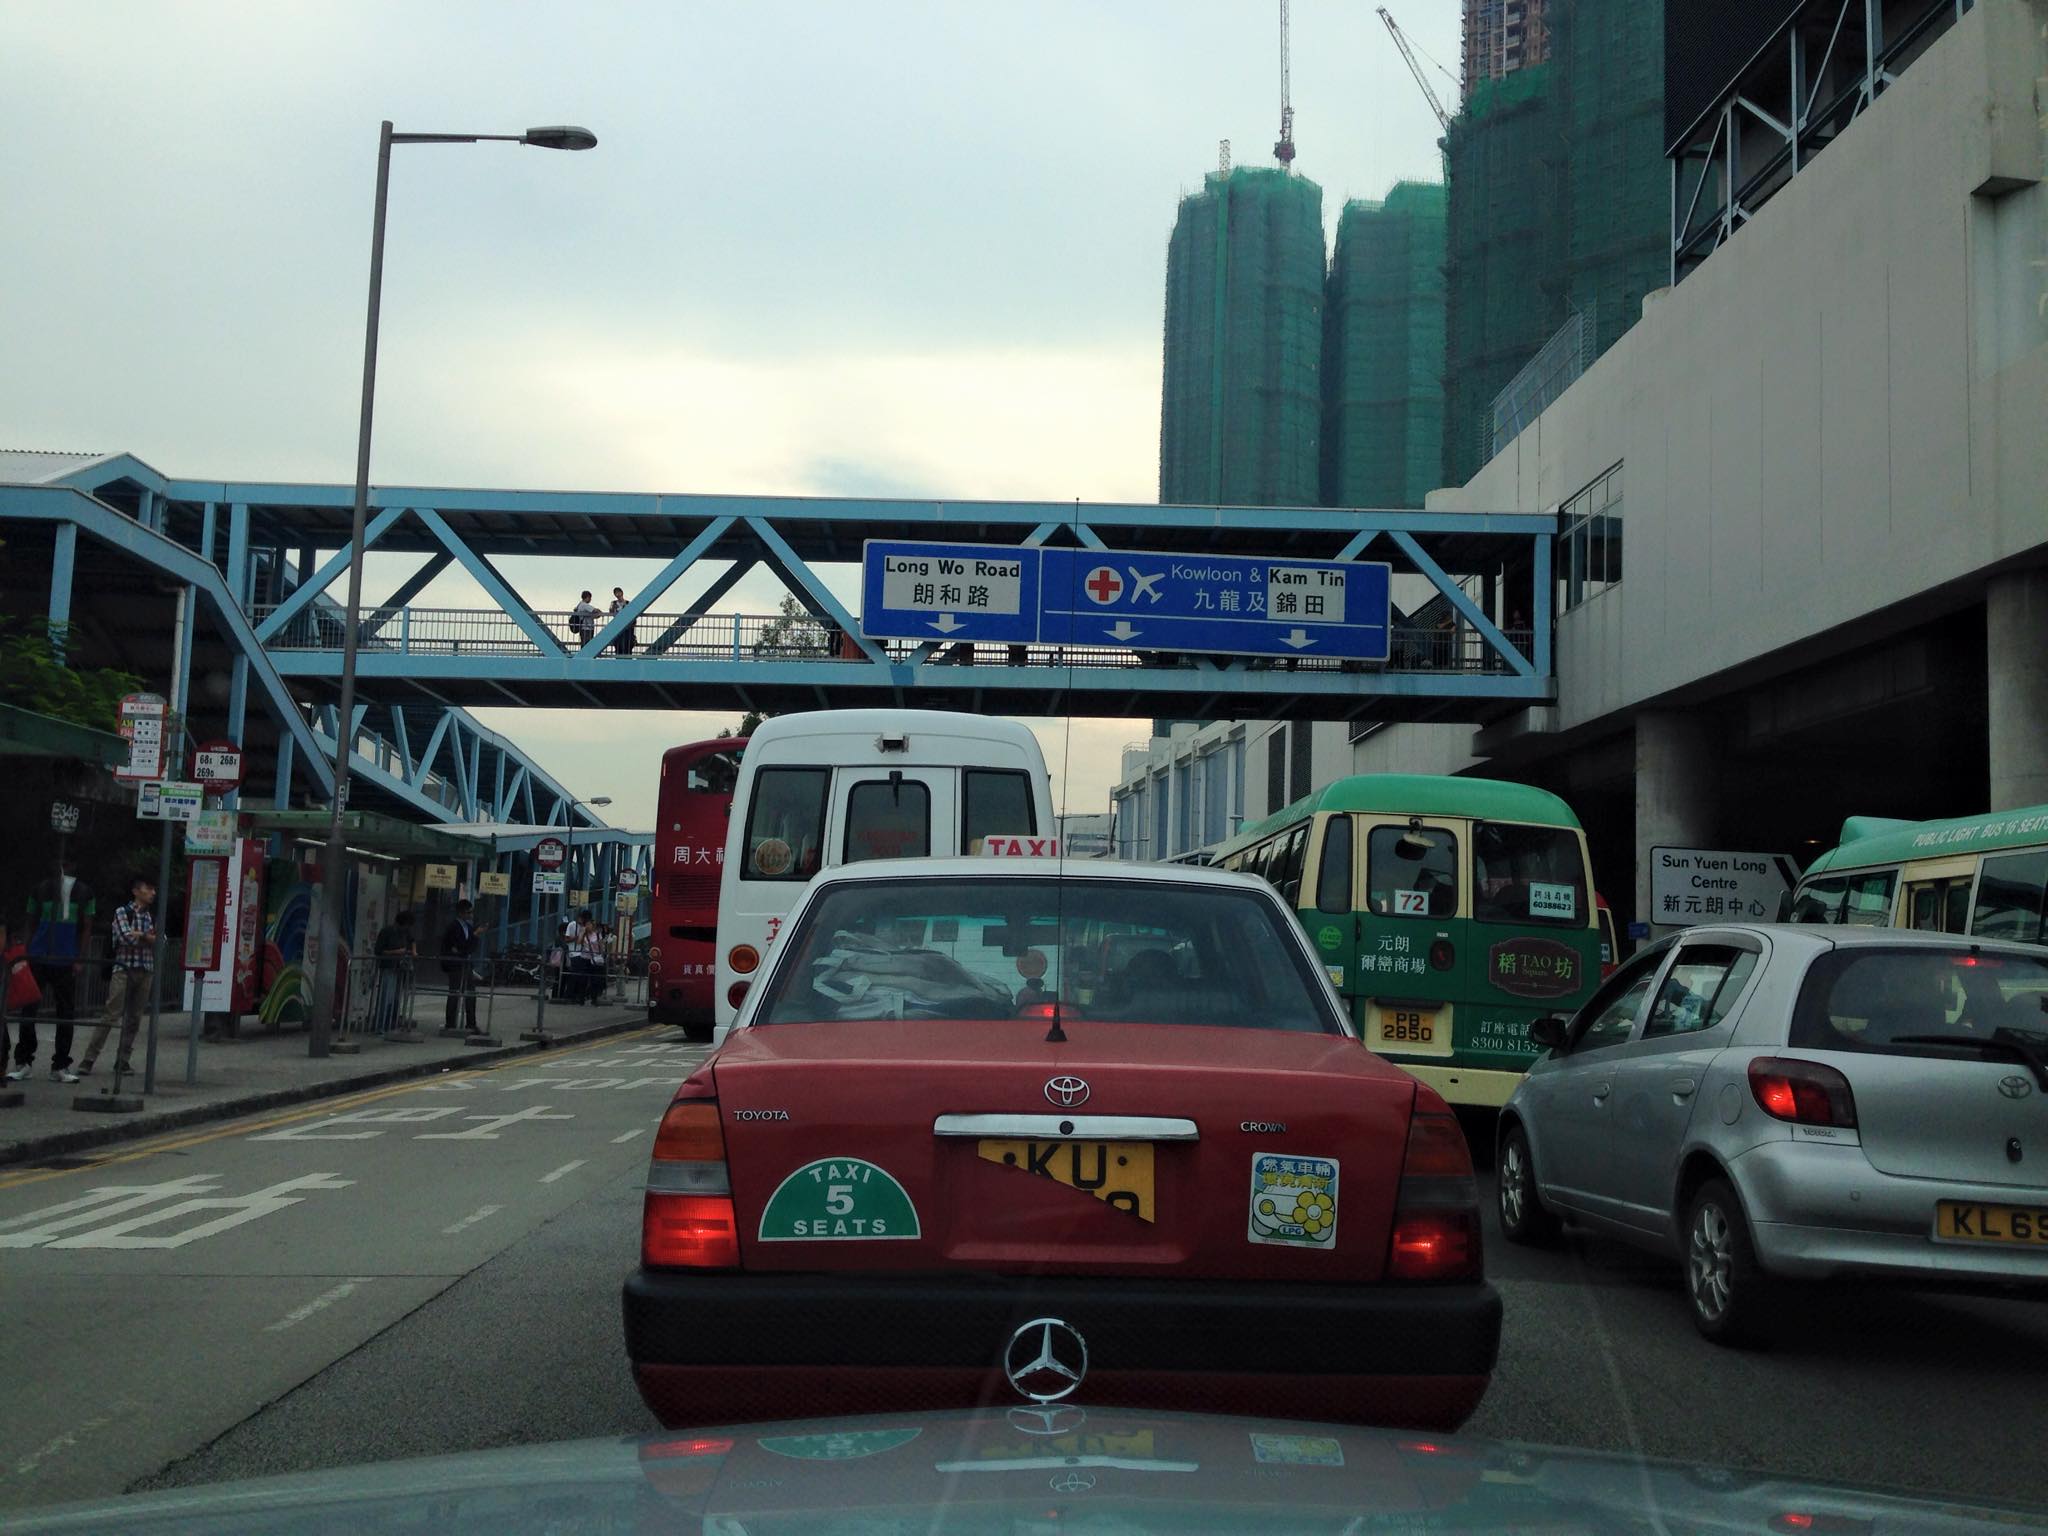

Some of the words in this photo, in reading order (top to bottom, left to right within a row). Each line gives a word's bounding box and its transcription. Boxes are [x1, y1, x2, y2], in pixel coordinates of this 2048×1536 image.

[886, 557, 929, 576] Long
[938, 559, 965, 575] Wo
[975, 561, 1020, 577] Road
[1171, 564, 1242, 582] Kowloon
[1250, 567, 1262, 582] &
[1269, 569, 1308, 585] Kam
[1317, 571, 1344, 586] Tin
[913, 583, 989, 607] 朗和路
[1912, 829, 1949, 847] PUBLIC
[1947, 826, 1980, 843] LIGHT
[1981, 822, 2005, 838] BUS
[2004, 819, 2020, 835] 16
[988, 839, 1057, 857] TAXI
[1662, 855, 1689, 868] Sun
[1694, 857, 1728, 870] Yuen
[1733, 858, 1767, 874] Long
[1691, 876, 1738, 889] Centre
[1400, 894, 1424, 911] 72
[1664, 894, 1766, 916] 新元朗中心
[1377, 935, 1410, 953] 元朗
[1361, 954, 1427, 975] 爾巒商場
[1498, 953, 1517, 975] 稻
[1519, 954, 1551, 969] TAO
[1554, 957, 1574, 979] 坊
[1395, 1012, 1420, 1026] PB
[1383, 1025, 1432, 1041] 2850
[1471, 1037, 1503, 1050] 8300
[540, 1058, 706, 1068] BUS
[733, 1110, 790, 1121] TOYOTA
[1240, 1121, 1287, 1132] CROWN
[1803, 1127, 1837, 1138] TOYOTA
[808, 1163, 872, 1184] TAXI
[825, 1184, 855, 1215] 5
[793, 1218, 887, 1235] SEATS
[1282, 1227, 1302, 1236] LPG
